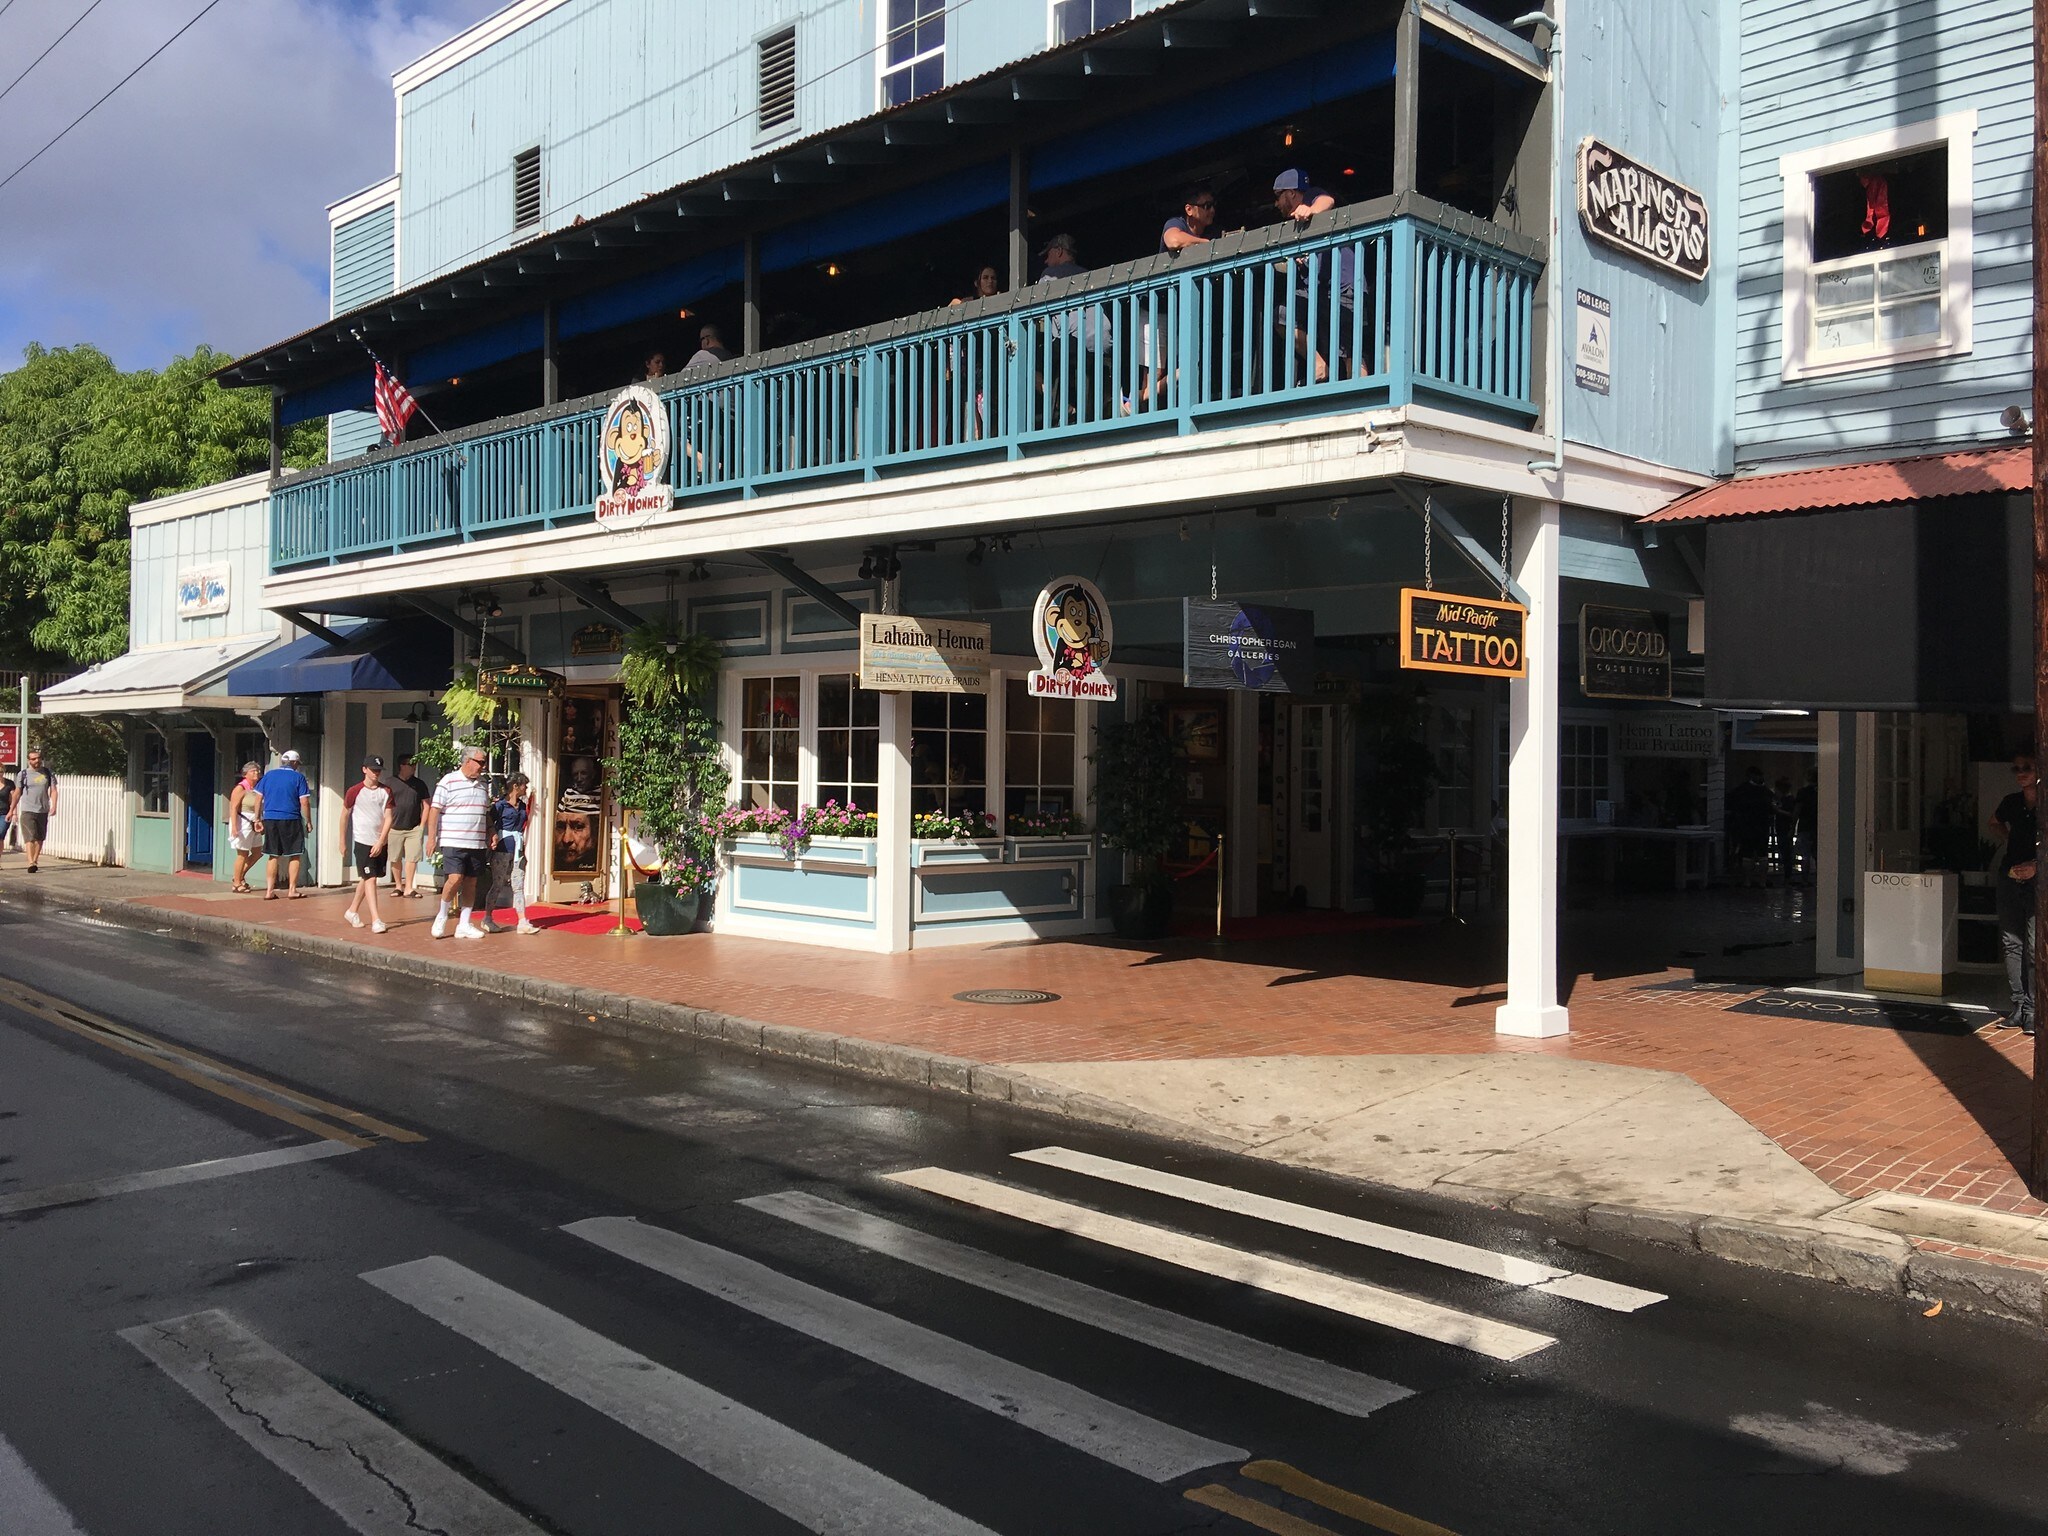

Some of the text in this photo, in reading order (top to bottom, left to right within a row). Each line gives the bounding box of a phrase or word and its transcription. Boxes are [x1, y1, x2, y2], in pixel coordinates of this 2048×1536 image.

[1578, 291, 1609, 313] FOR LEASE
[1581, 343, 1604, 358] AVALON
[627, 495, 665, 515] MONKEY
[1436, 604, 1498, 629] Mid-Pacific
[871, 624, 984, 650] Lahaina Henna
[1209, 634, 1296, 649] CHRISTOPHER EGAN
[1589, 626, 1665, 658] OROGOLD
[1227, 650, 1279, 661] GALLERIES
[1415, 627, 1518, 667] TATTOO
[1596, 663, 1661, 675] COSMETICS
[875, 673, 980, 686] HENNA TATTOO & BRAIDS
[1072, 680, 1114, 697] MONKEY
[1618, 723, 1712, 738] Henna Tattoo
[1618, 738, 1713, 755] Hair Braiding
[608, 771, 619, 884] ALLERY
[1871, 874, 1933, 888] OROGL
[1756, 997, 1968, 1023] OROGOLD
